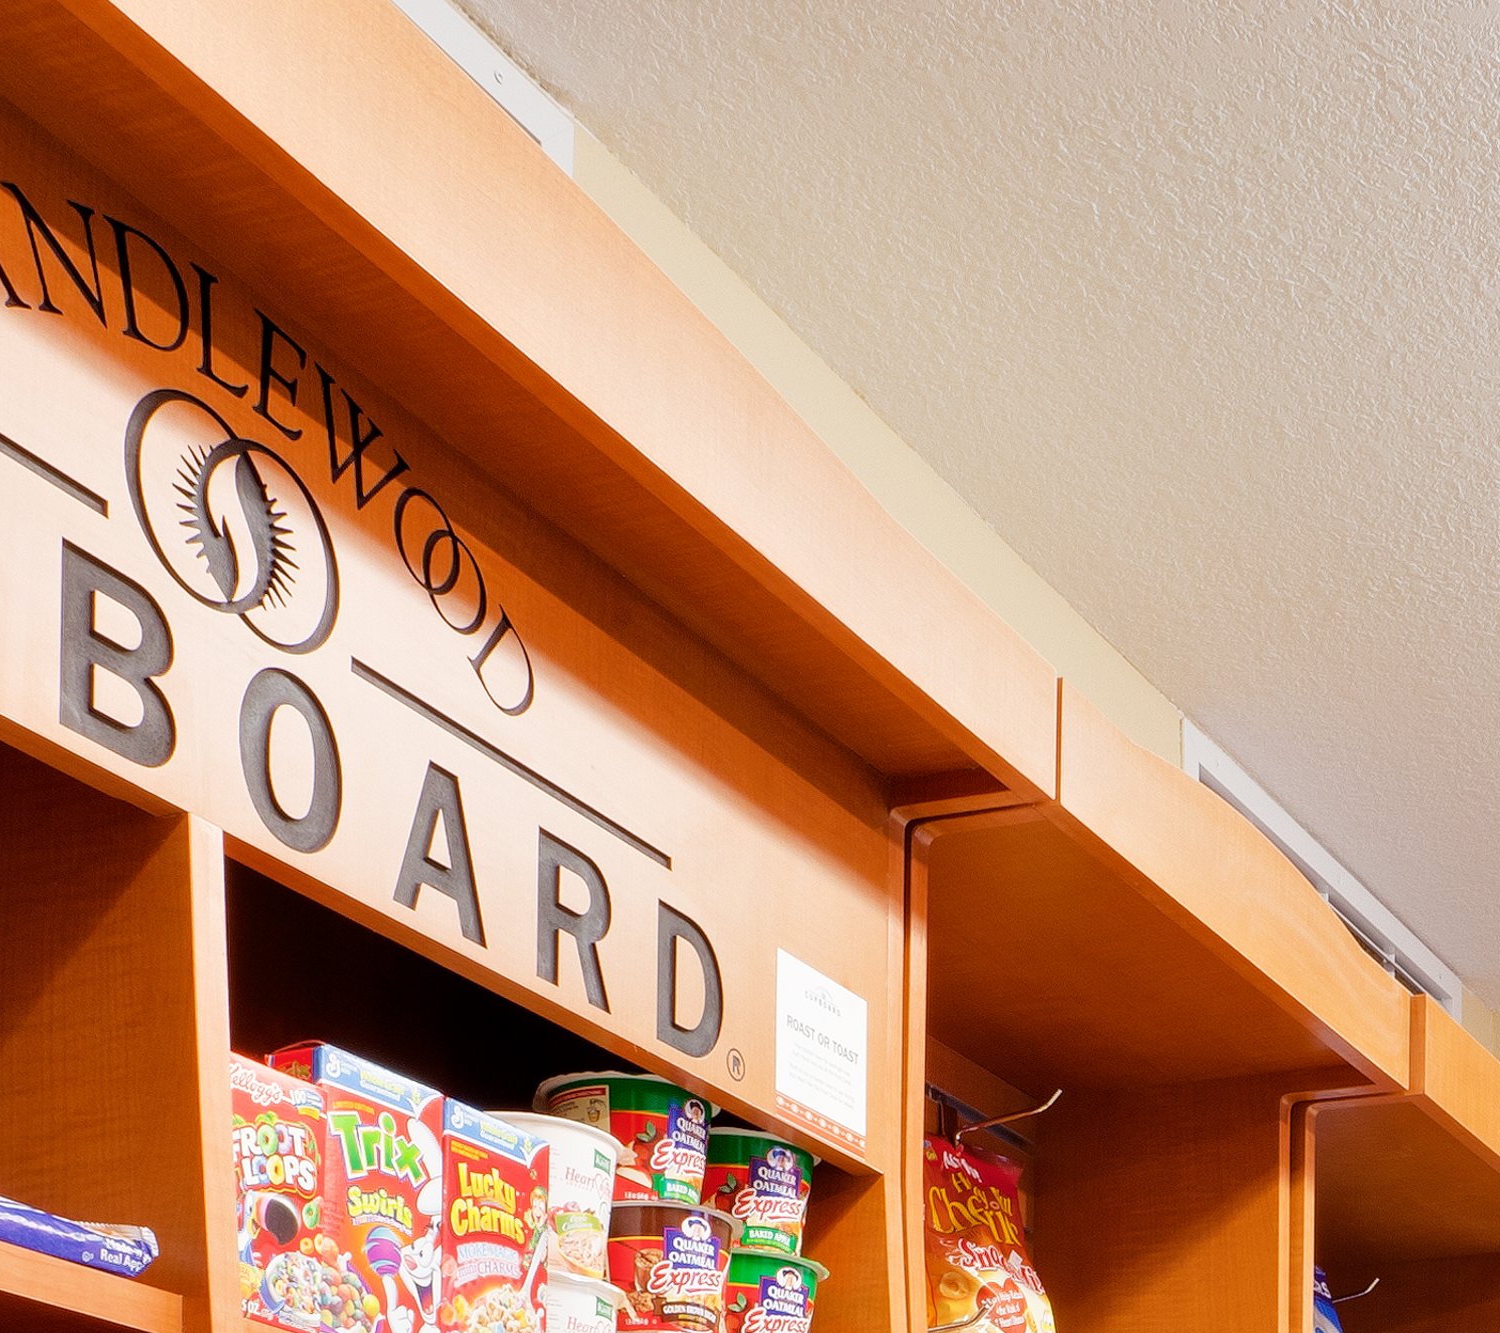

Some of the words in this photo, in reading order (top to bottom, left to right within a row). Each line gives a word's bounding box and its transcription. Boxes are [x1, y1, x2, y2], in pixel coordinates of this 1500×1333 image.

[786, 1014, 816, 1041] ROAST
[818, 1033, 830, 1050] OR
[832, 1041, 859, 1064] TOAST
[233, 1122, 306, 1162] FROOT
[328, 1112, 427, 1188] Trix
[241, 1156, 315, 1192] LOOPS
[458, 1162, 517, 1214] Lucky
[753, 1180, 796, 1198] OATMEAL
[758, 1167, 797, 1186] QUAKER
[347, 1186, 413, 1230] Swirls
[450, 1198, 525, 1244] Charms
[734, 1189, 802, 1220] Express
[669, 1252, 715, 1270] OATMEAL
[673, 1237, 714, 1256] QUAKER
[648, 1263, 721, 1293] Express
